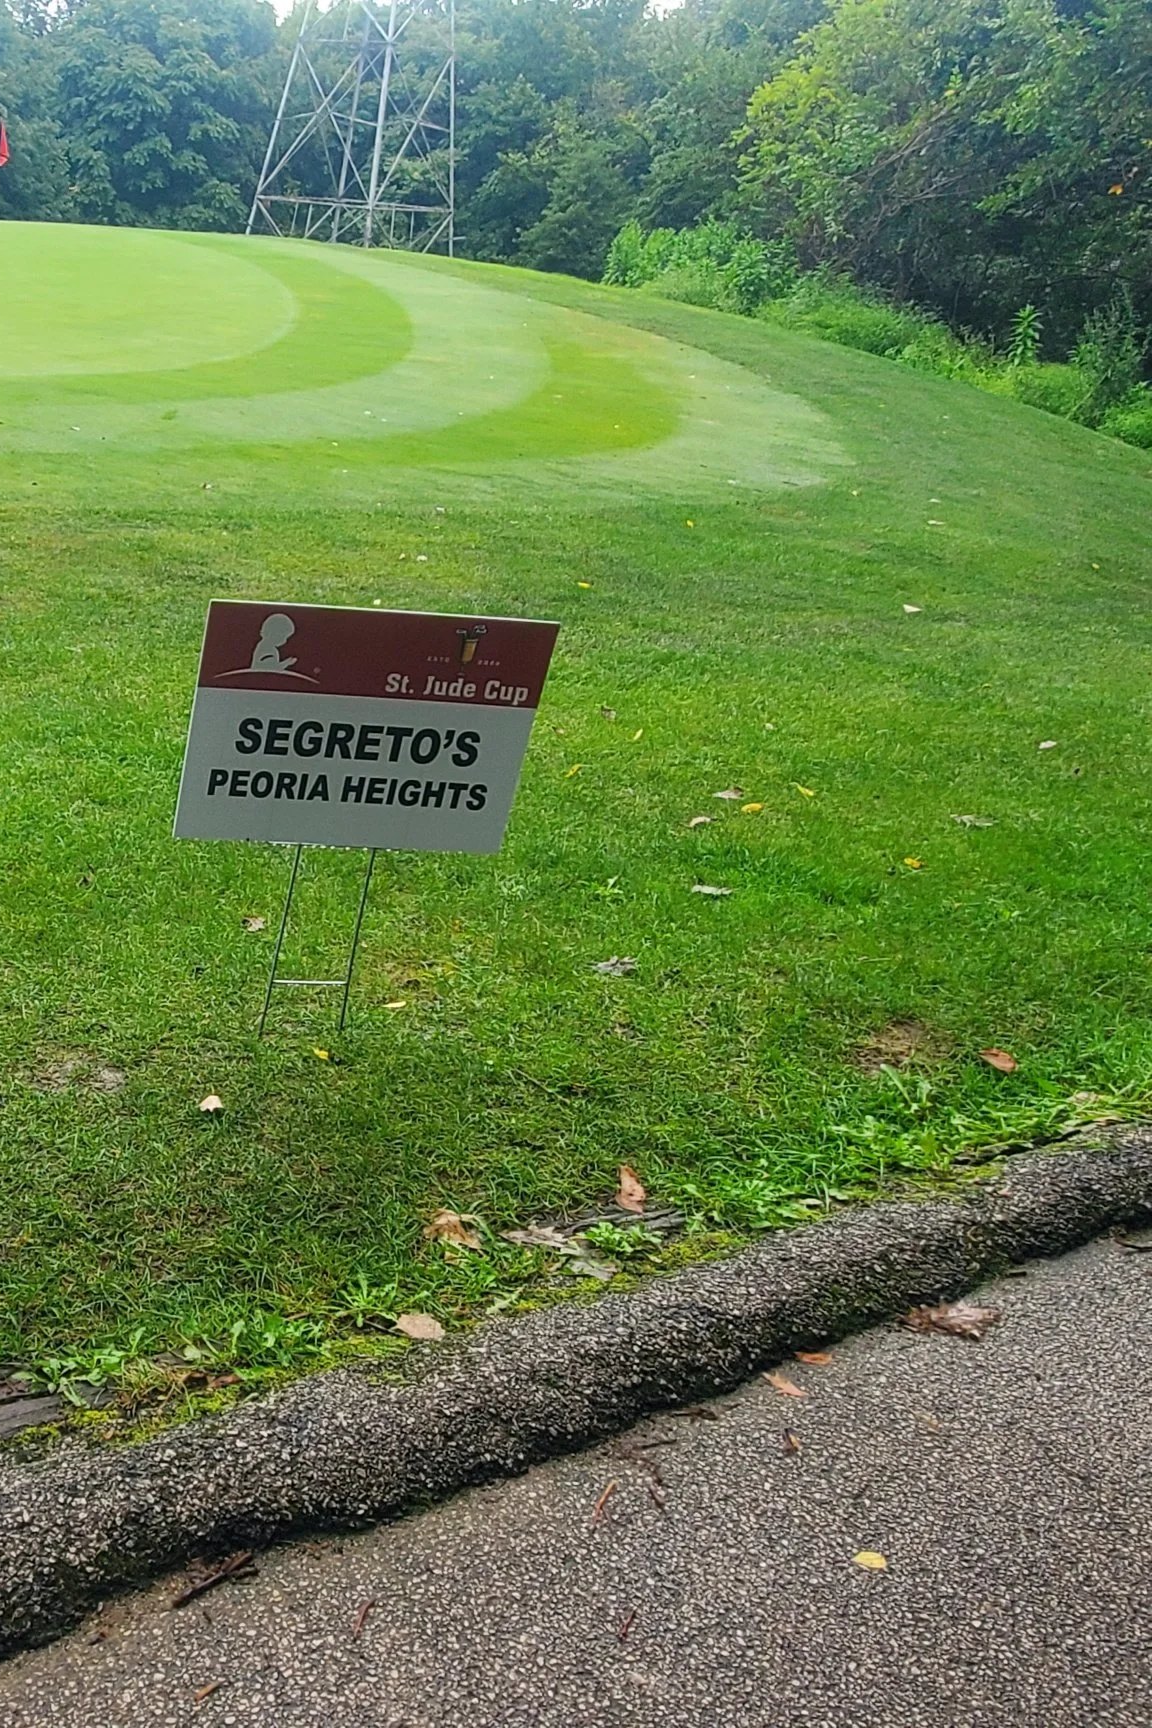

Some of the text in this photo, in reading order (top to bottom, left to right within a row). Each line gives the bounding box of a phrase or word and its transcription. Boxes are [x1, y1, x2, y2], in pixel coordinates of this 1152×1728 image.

[385, 673, 529, 706] St. Jude Cup
[234, 717, 482, 768] SEGRETO'S
[206, 768, 488, 811] PEORIA HEIGHTS
